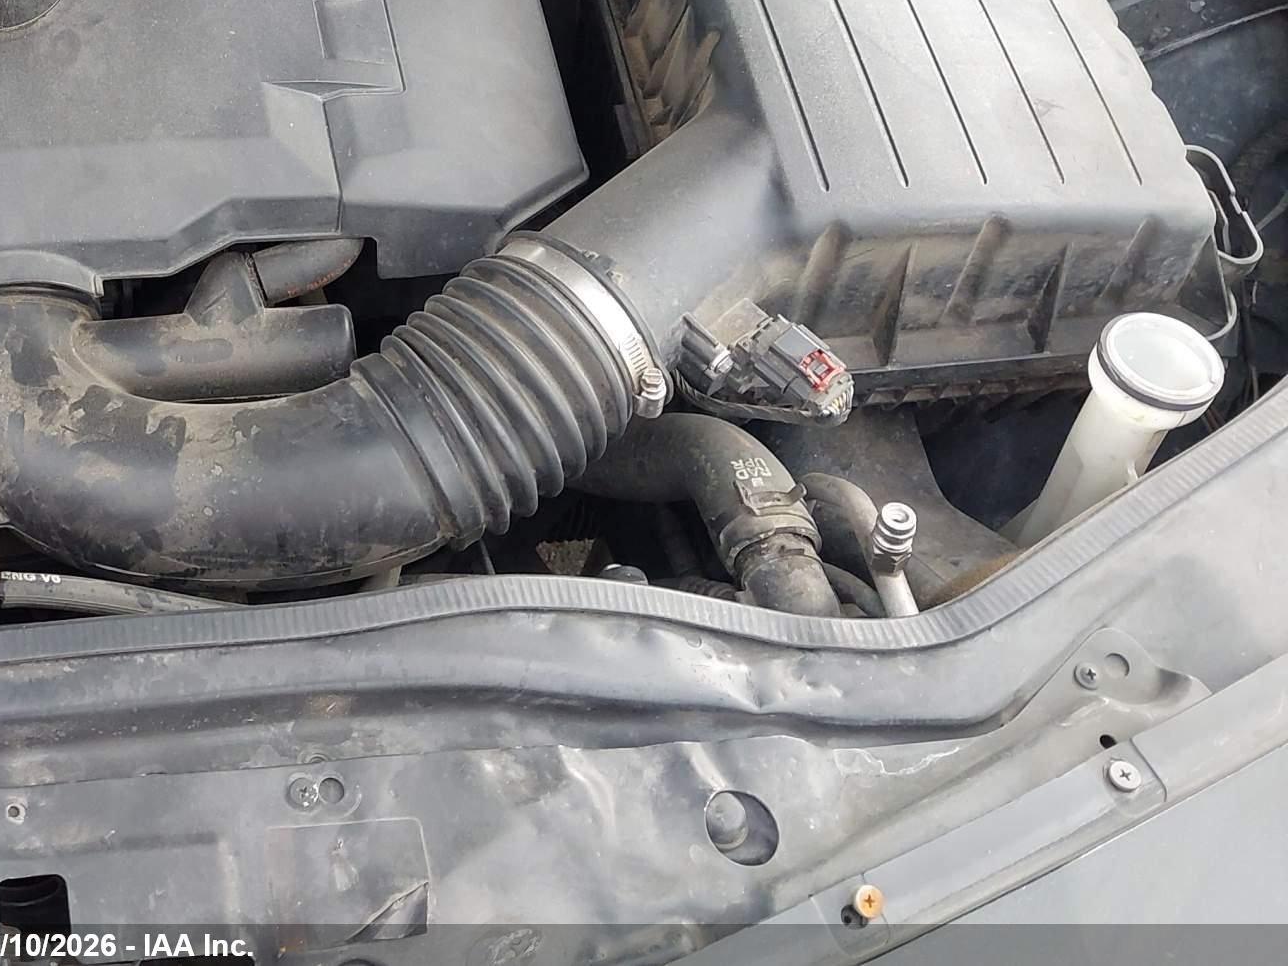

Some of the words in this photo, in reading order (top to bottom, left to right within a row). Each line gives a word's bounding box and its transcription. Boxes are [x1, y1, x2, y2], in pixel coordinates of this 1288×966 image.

[730, 457, 768, 471] UPR
[735, 465, 772, 480] RAD
[0, 571, 36, 582] ENG
[40, 573, 62, 584] V6
